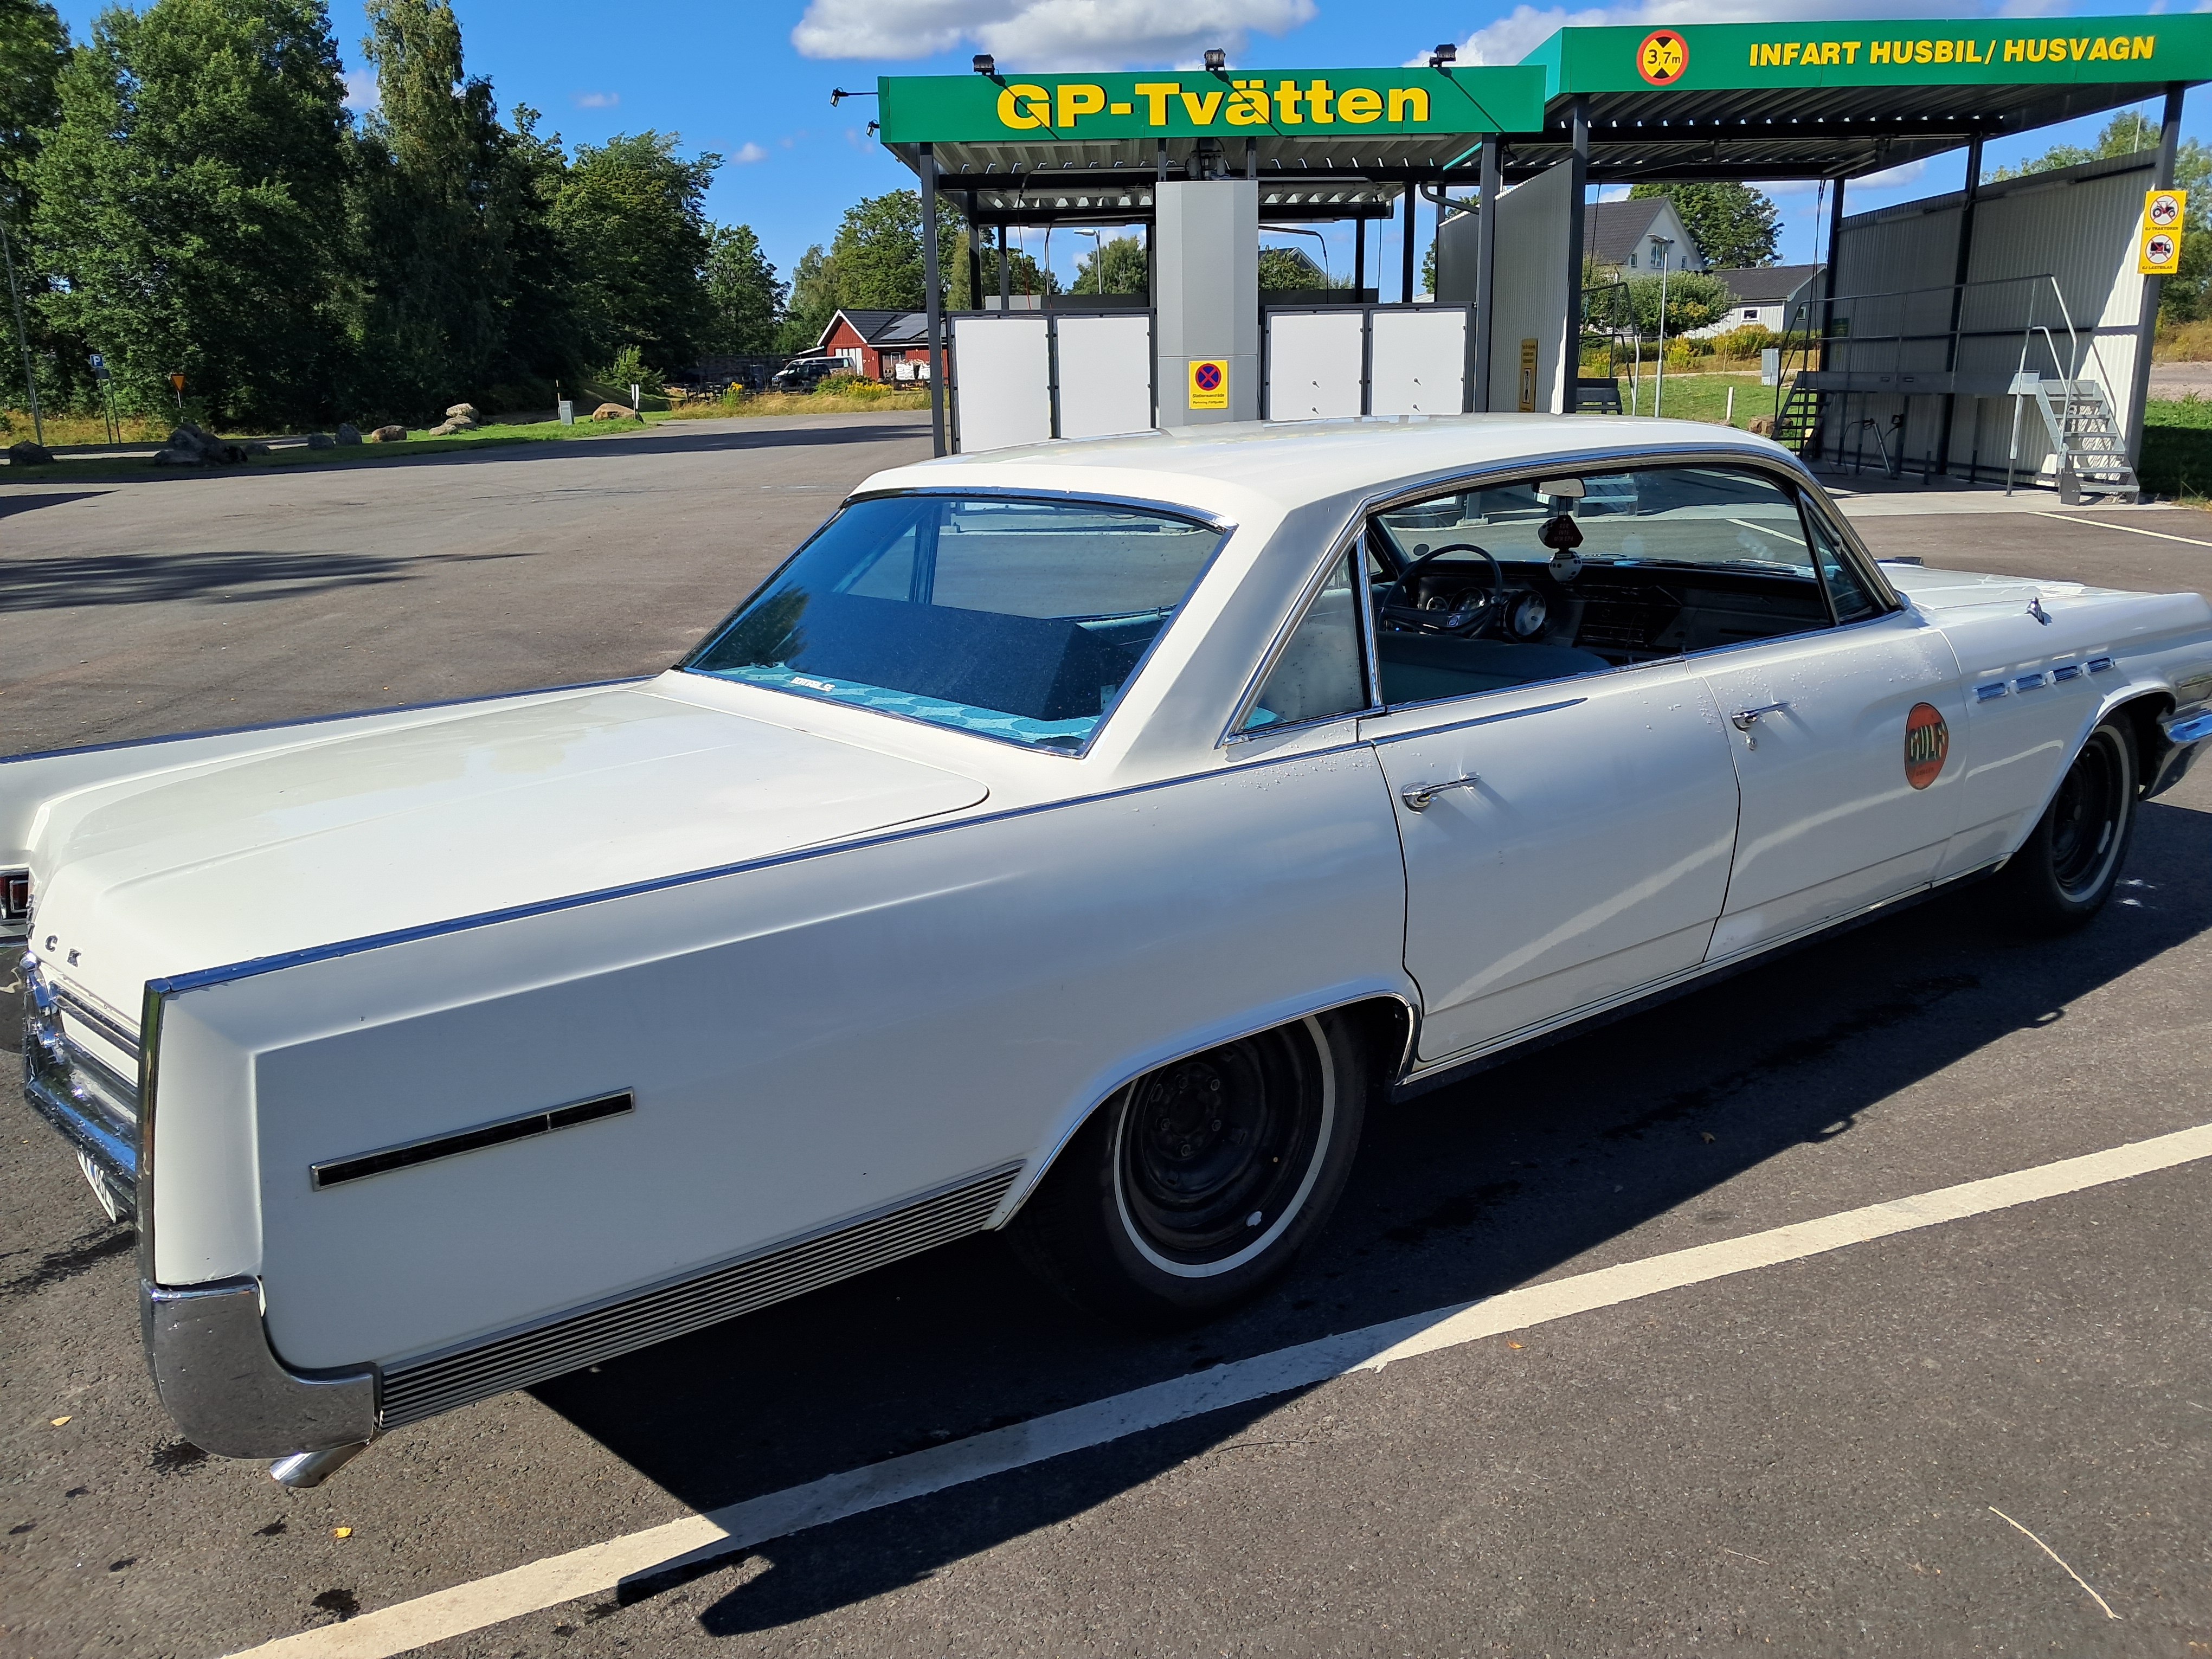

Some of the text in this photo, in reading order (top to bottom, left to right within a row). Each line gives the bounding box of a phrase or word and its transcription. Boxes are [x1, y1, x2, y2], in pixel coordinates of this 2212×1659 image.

[1749, 41, 1862, 66] INFART
[2003, 36, 2156, 63] HUSVAGN
[996, 79, 1431, 130] GP-Tvätten
[93, 356, 100, 365] P
[1908, 722, 1946, 763] GULF
